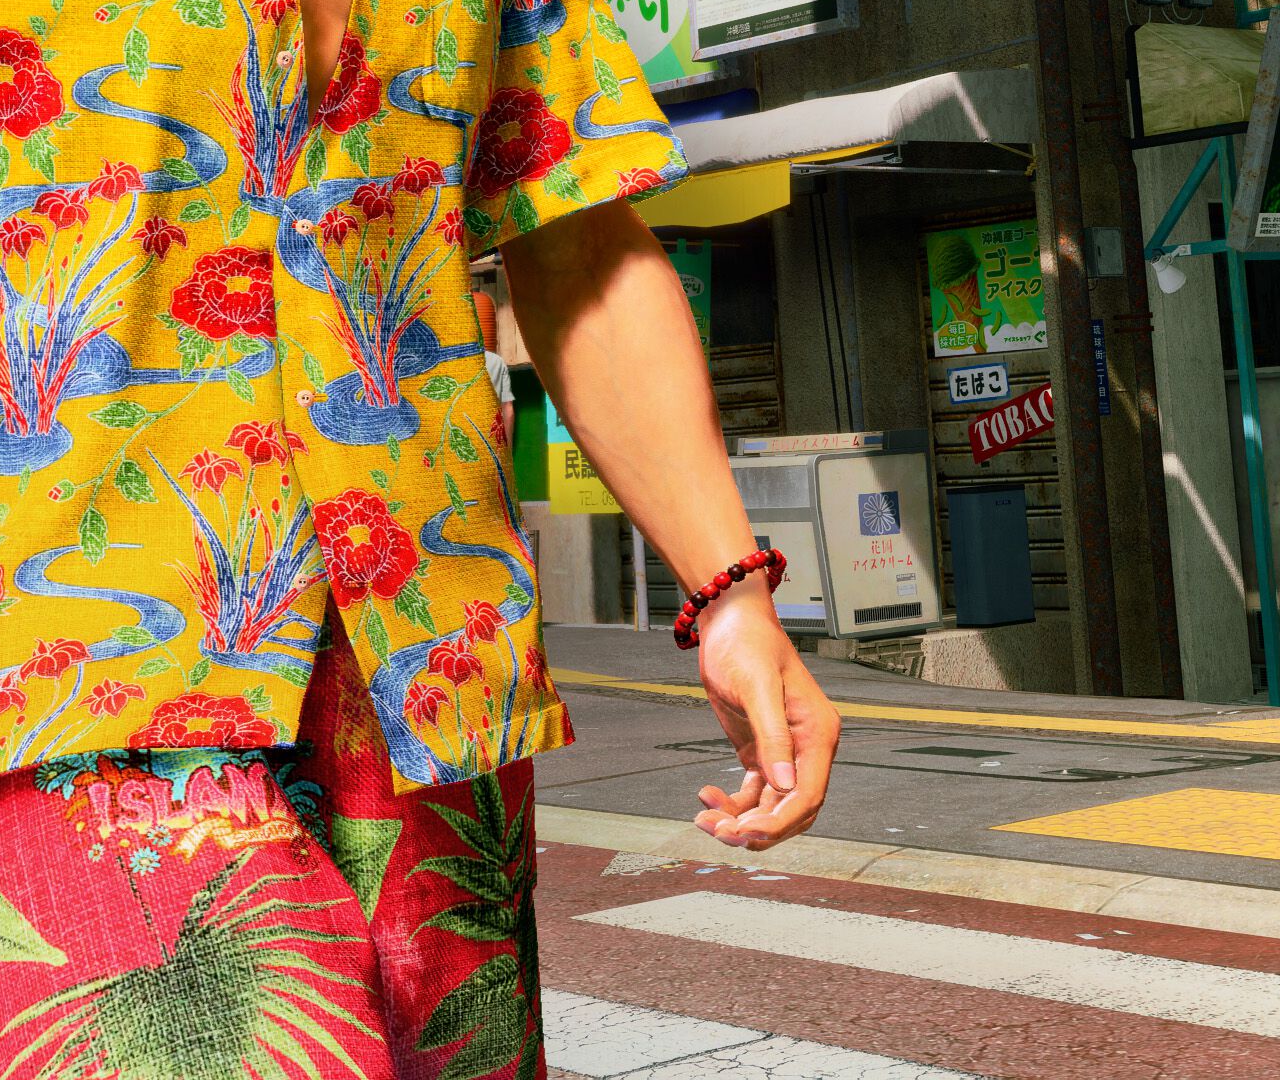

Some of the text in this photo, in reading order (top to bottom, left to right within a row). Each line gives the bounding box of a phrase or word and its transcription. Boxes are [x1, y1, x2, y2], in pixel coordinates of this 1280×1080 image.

[982, 227, 1038, 245] 沖縄産ゴー
[985, 247, 1040, 278] ゴー
[955, 371, 1002, 397] たばこ
[852, 555, 913, 571] アイスクリーム
